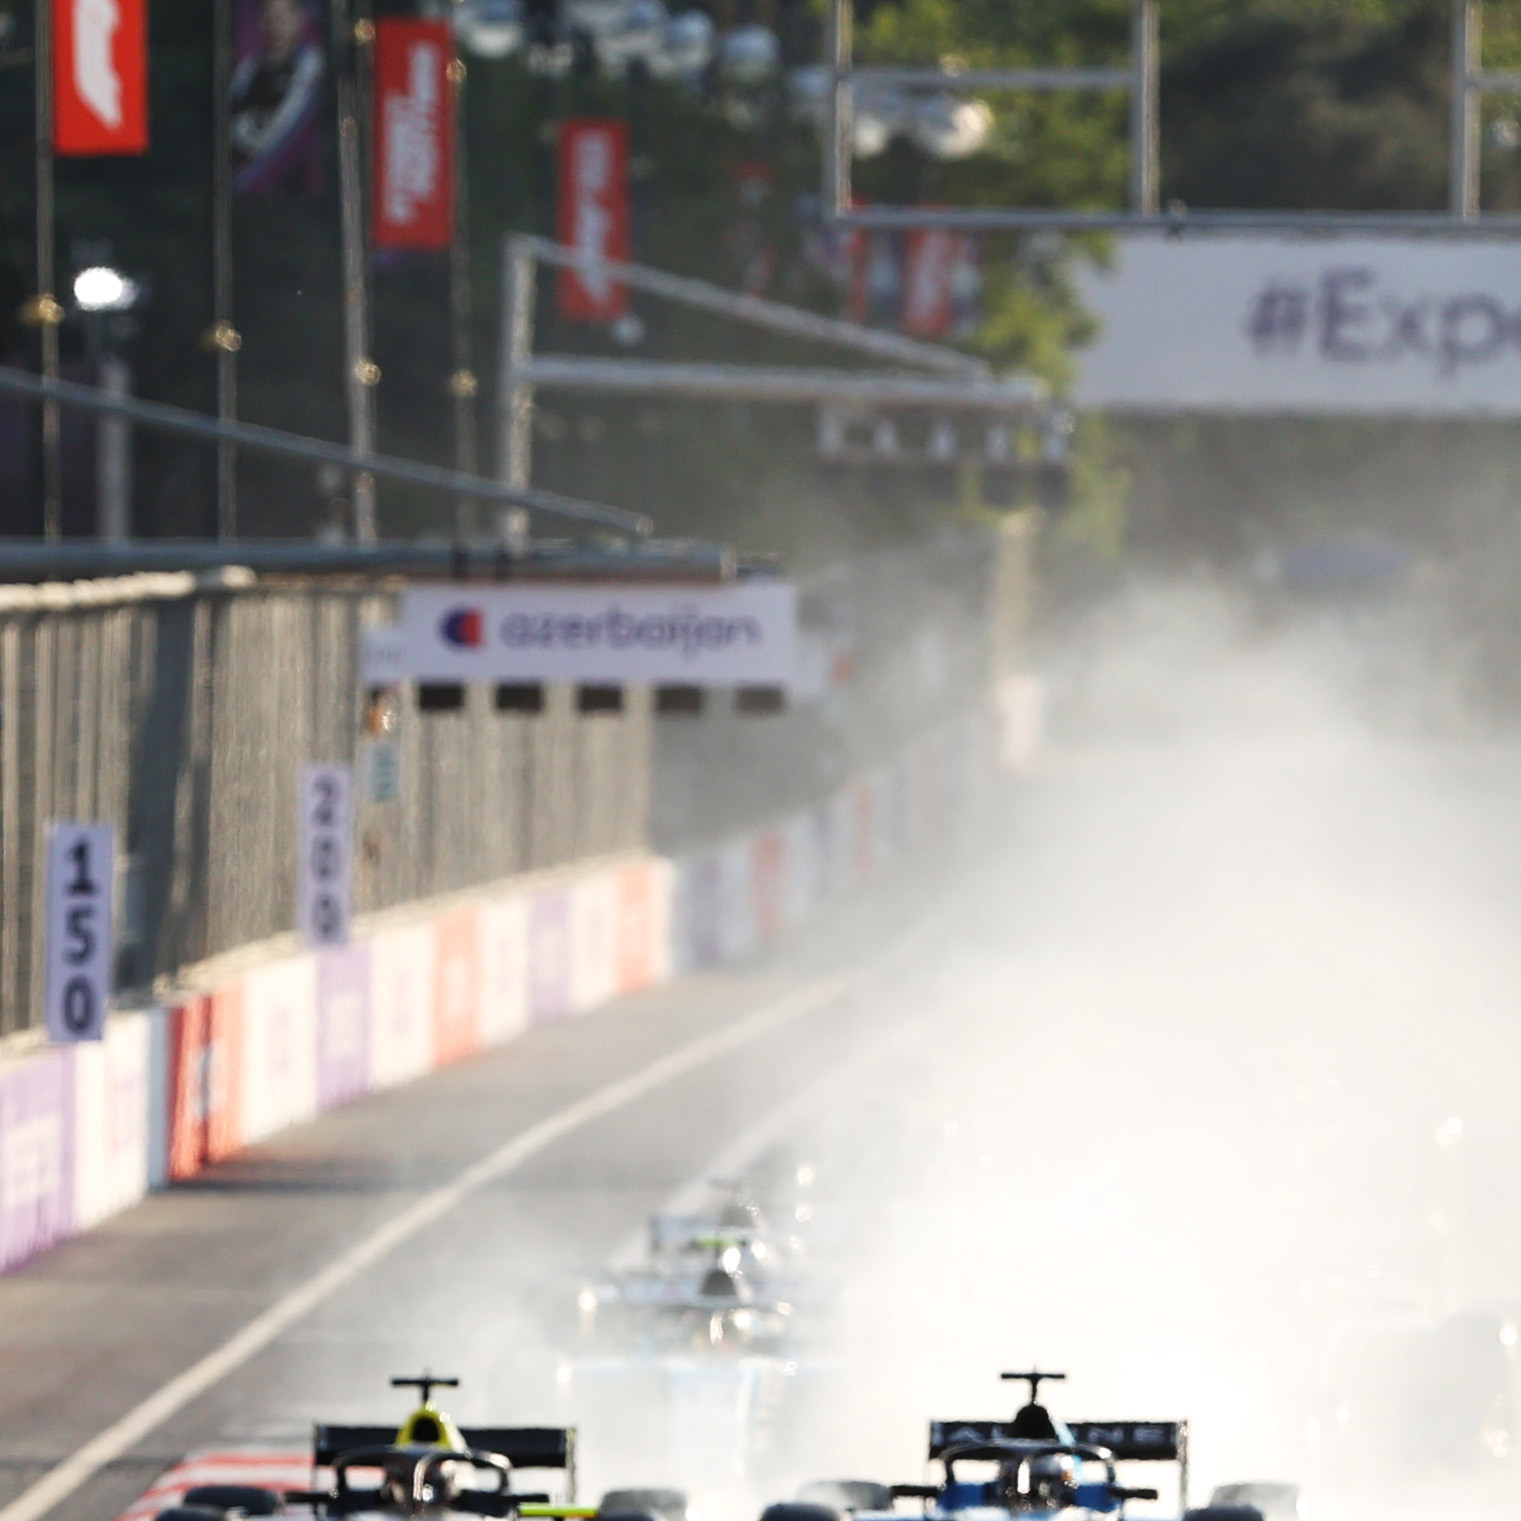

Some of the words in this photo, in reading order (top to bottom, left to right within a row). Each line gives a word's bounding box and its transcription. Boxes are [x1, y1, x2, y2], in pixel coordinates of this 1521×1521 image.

[500, 607, 763, 662] azerbaijan
[65, 841, 97, 1034] 150
[948, 1425, 1166, 1444] ALNE
